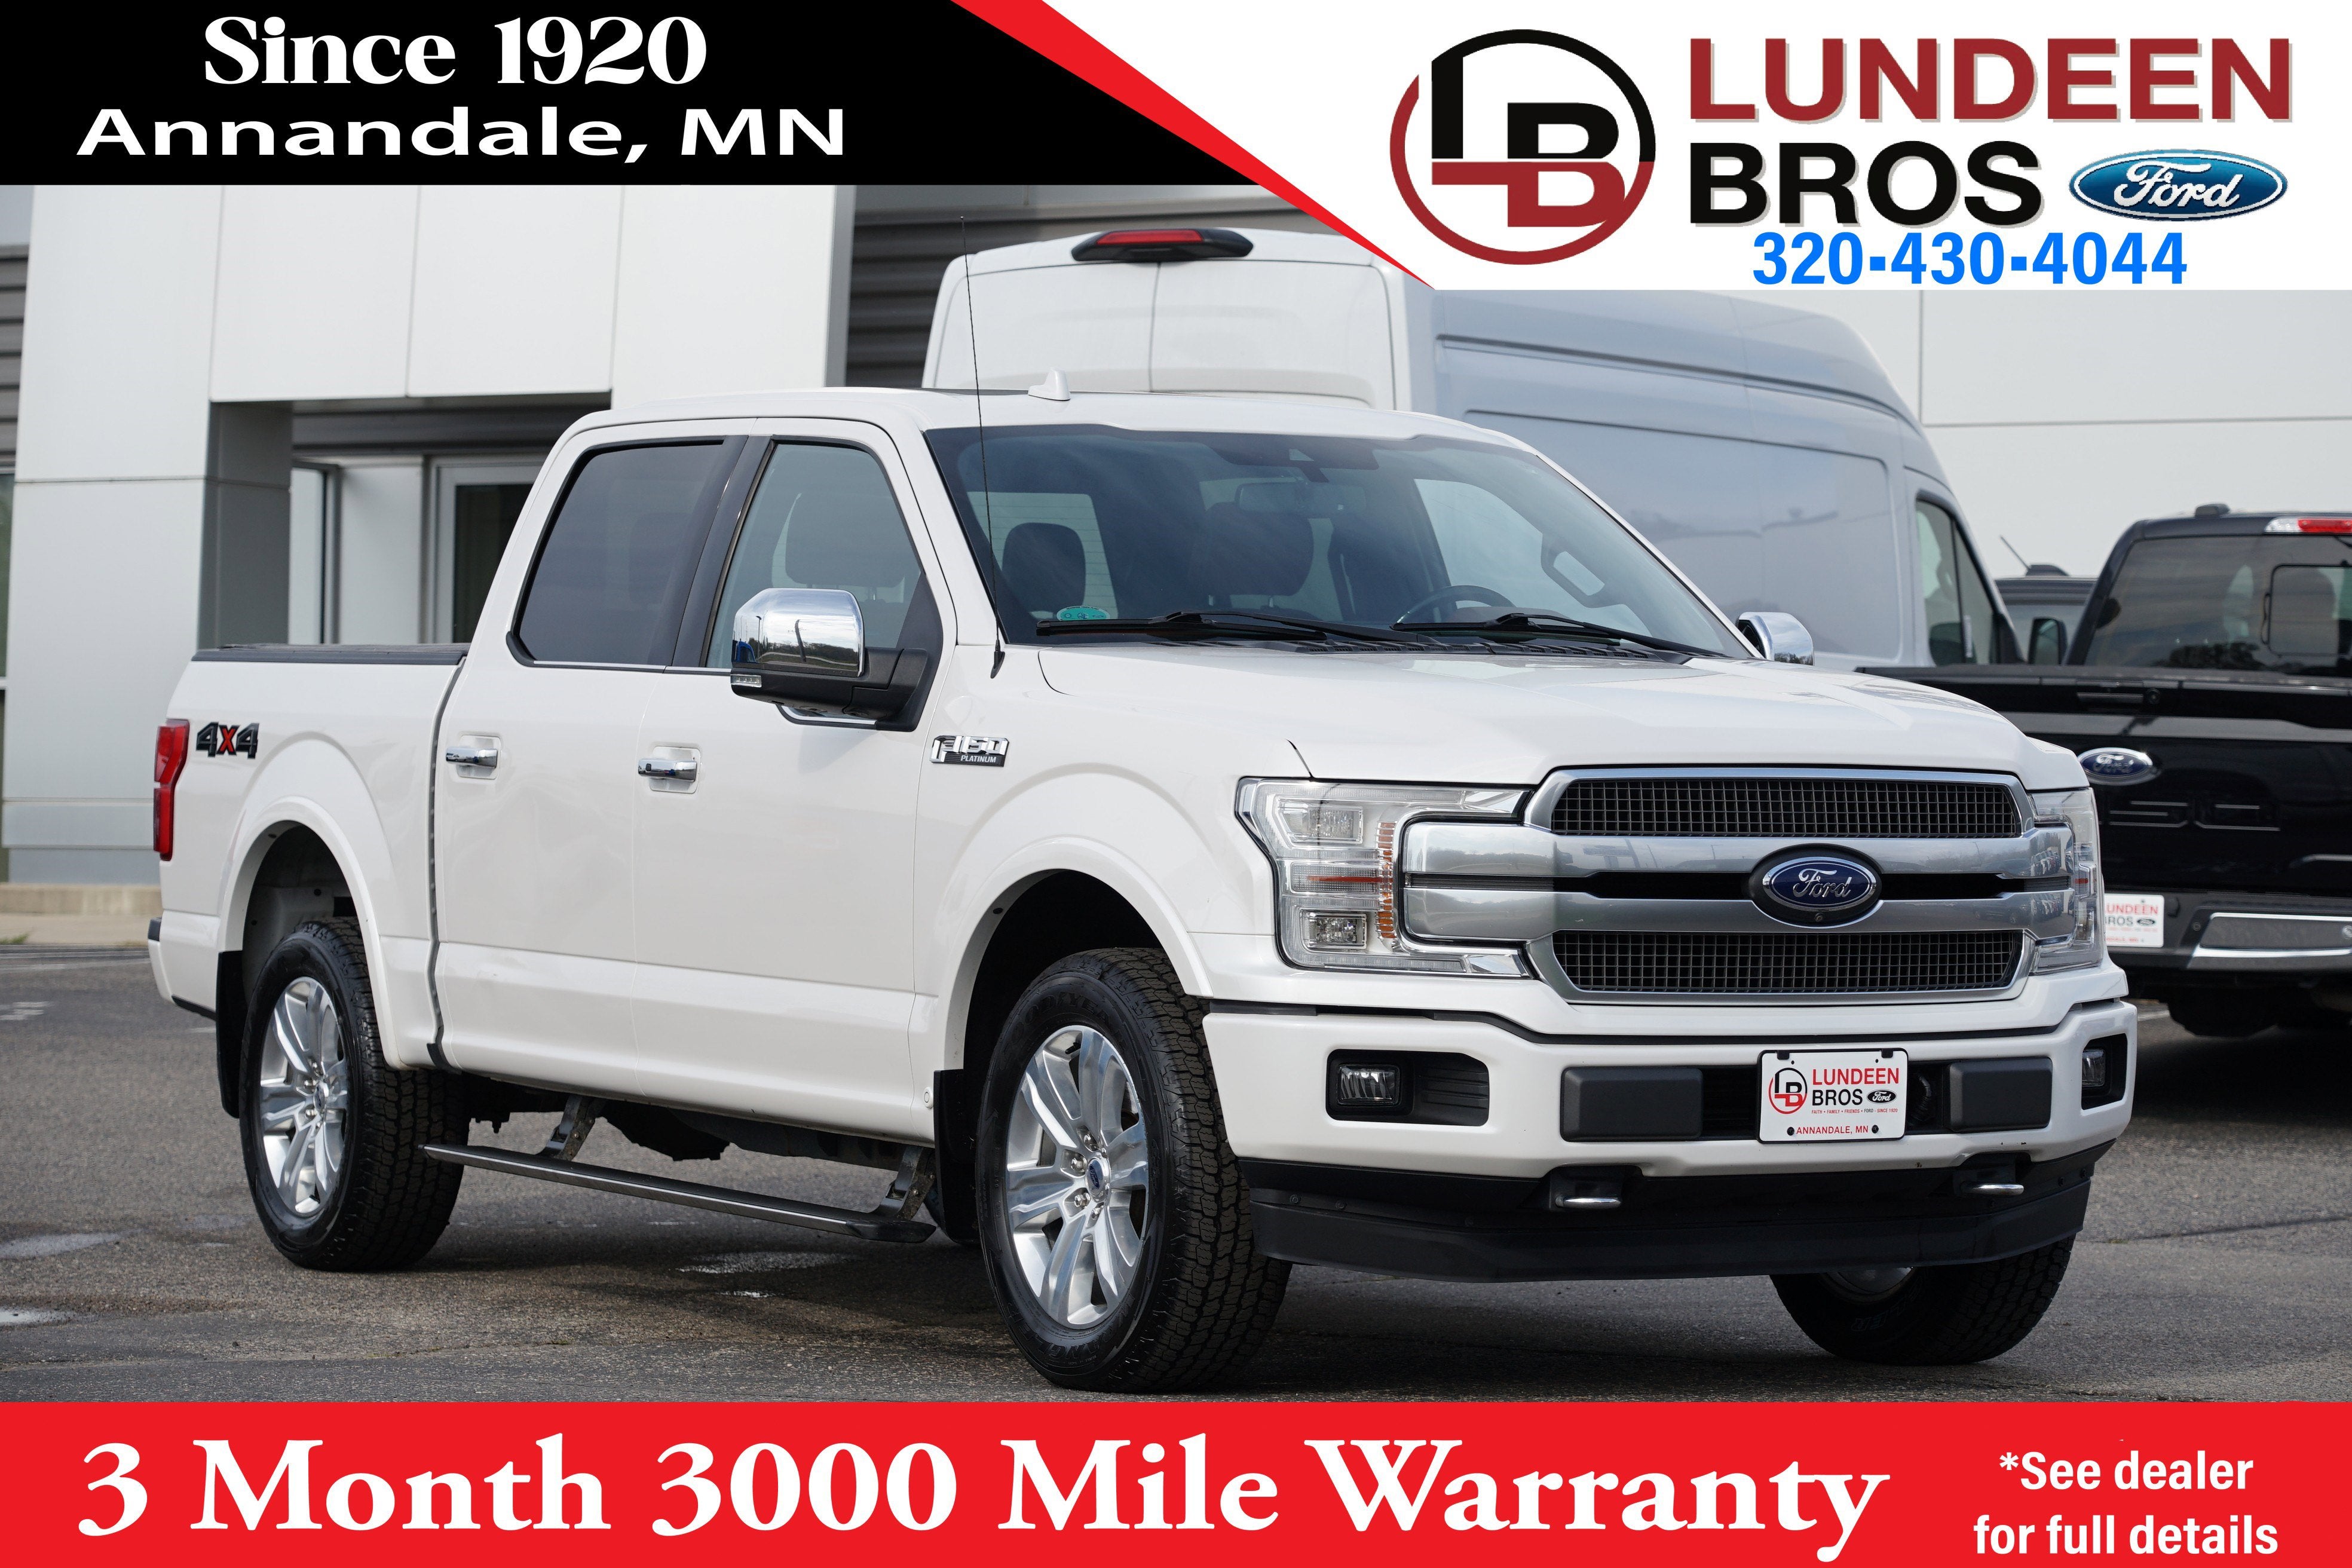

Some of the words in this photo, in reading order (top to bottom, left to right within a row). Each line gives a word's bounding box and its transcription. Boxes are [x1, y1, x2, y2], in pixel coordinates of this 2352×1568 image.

[960, 755, 997, 763] PLATINUM
[1793, 868, 1852, 898] Ford
[2105, 904, 2158, 915] UNDEEN
[2105, 915, 2133, 926] ROS
[1812, 1068, 1899, 1085] LUNDEEN
[1812, 1089, 1863, 1105] BROS
[1796, 1126, 1852, 1134] ANNANDALE,
